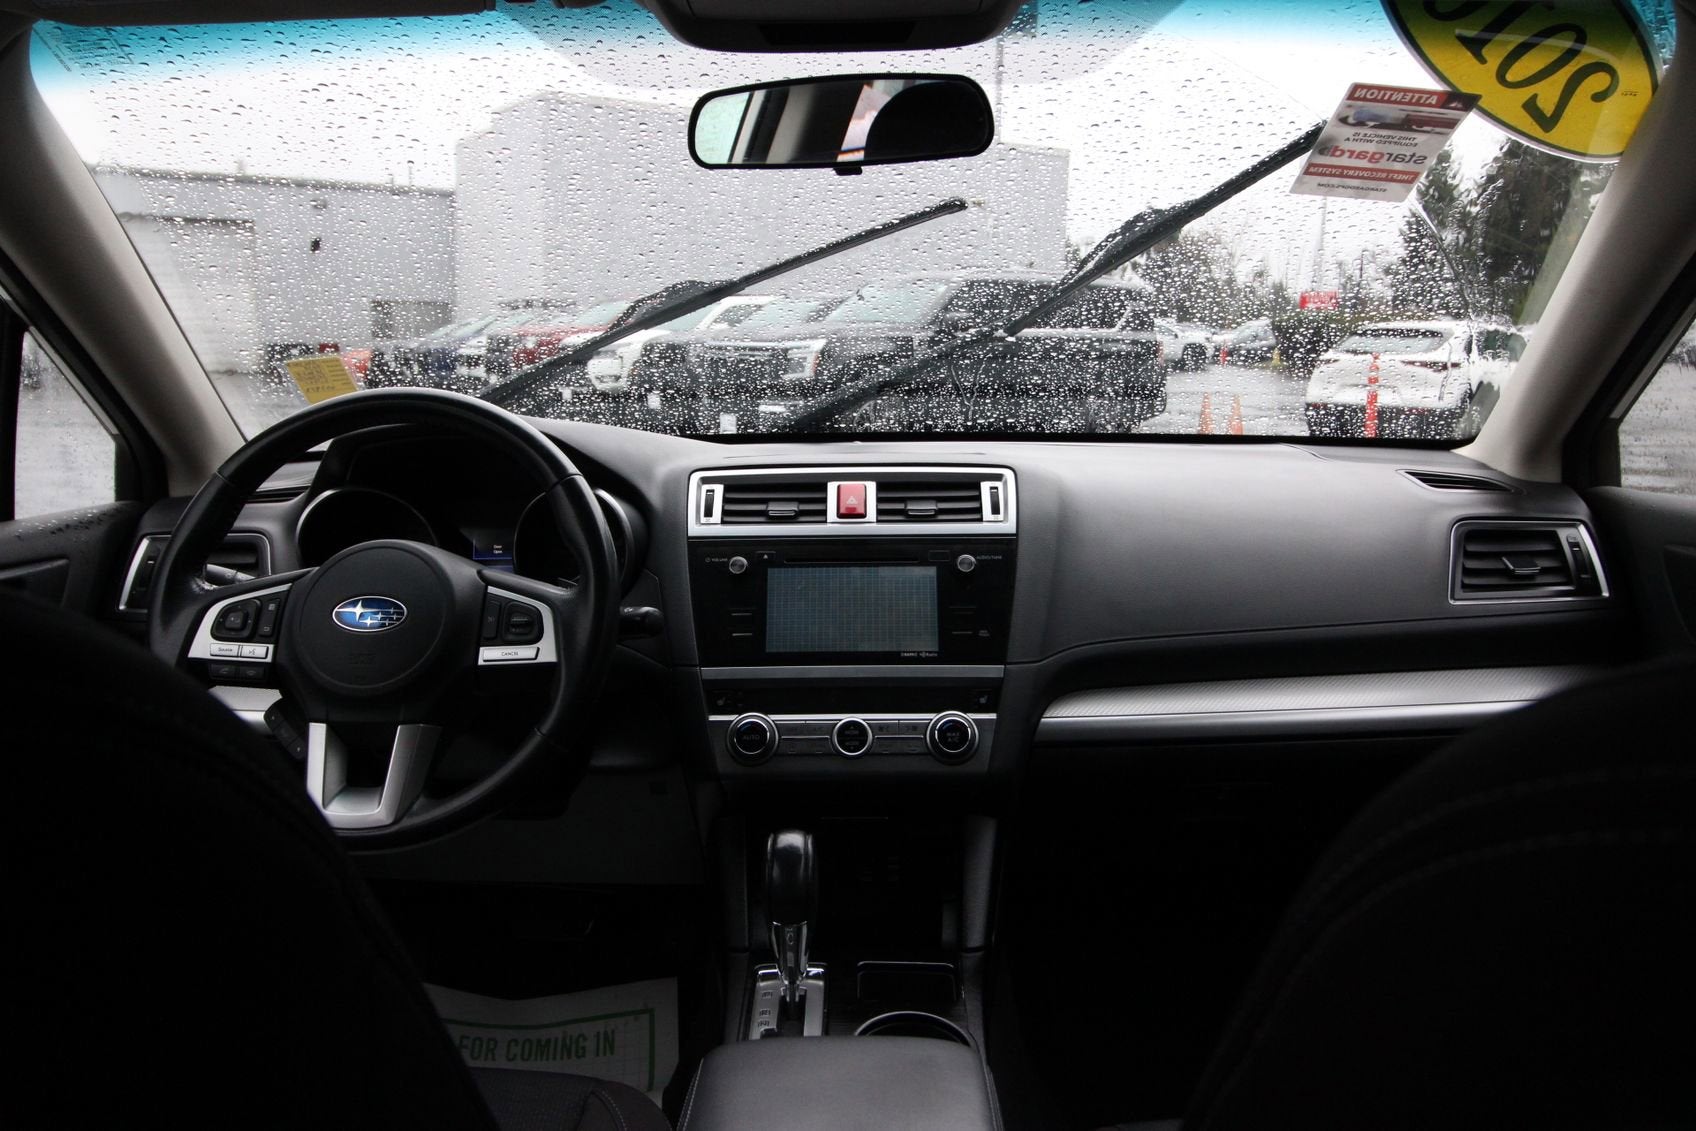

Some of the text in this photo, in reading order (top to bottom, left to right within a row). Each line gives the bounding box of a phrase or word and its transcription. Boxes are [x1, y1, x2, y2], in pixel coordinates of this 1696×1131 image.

[458, 1028, 616, 1062] FOR COMING IN
